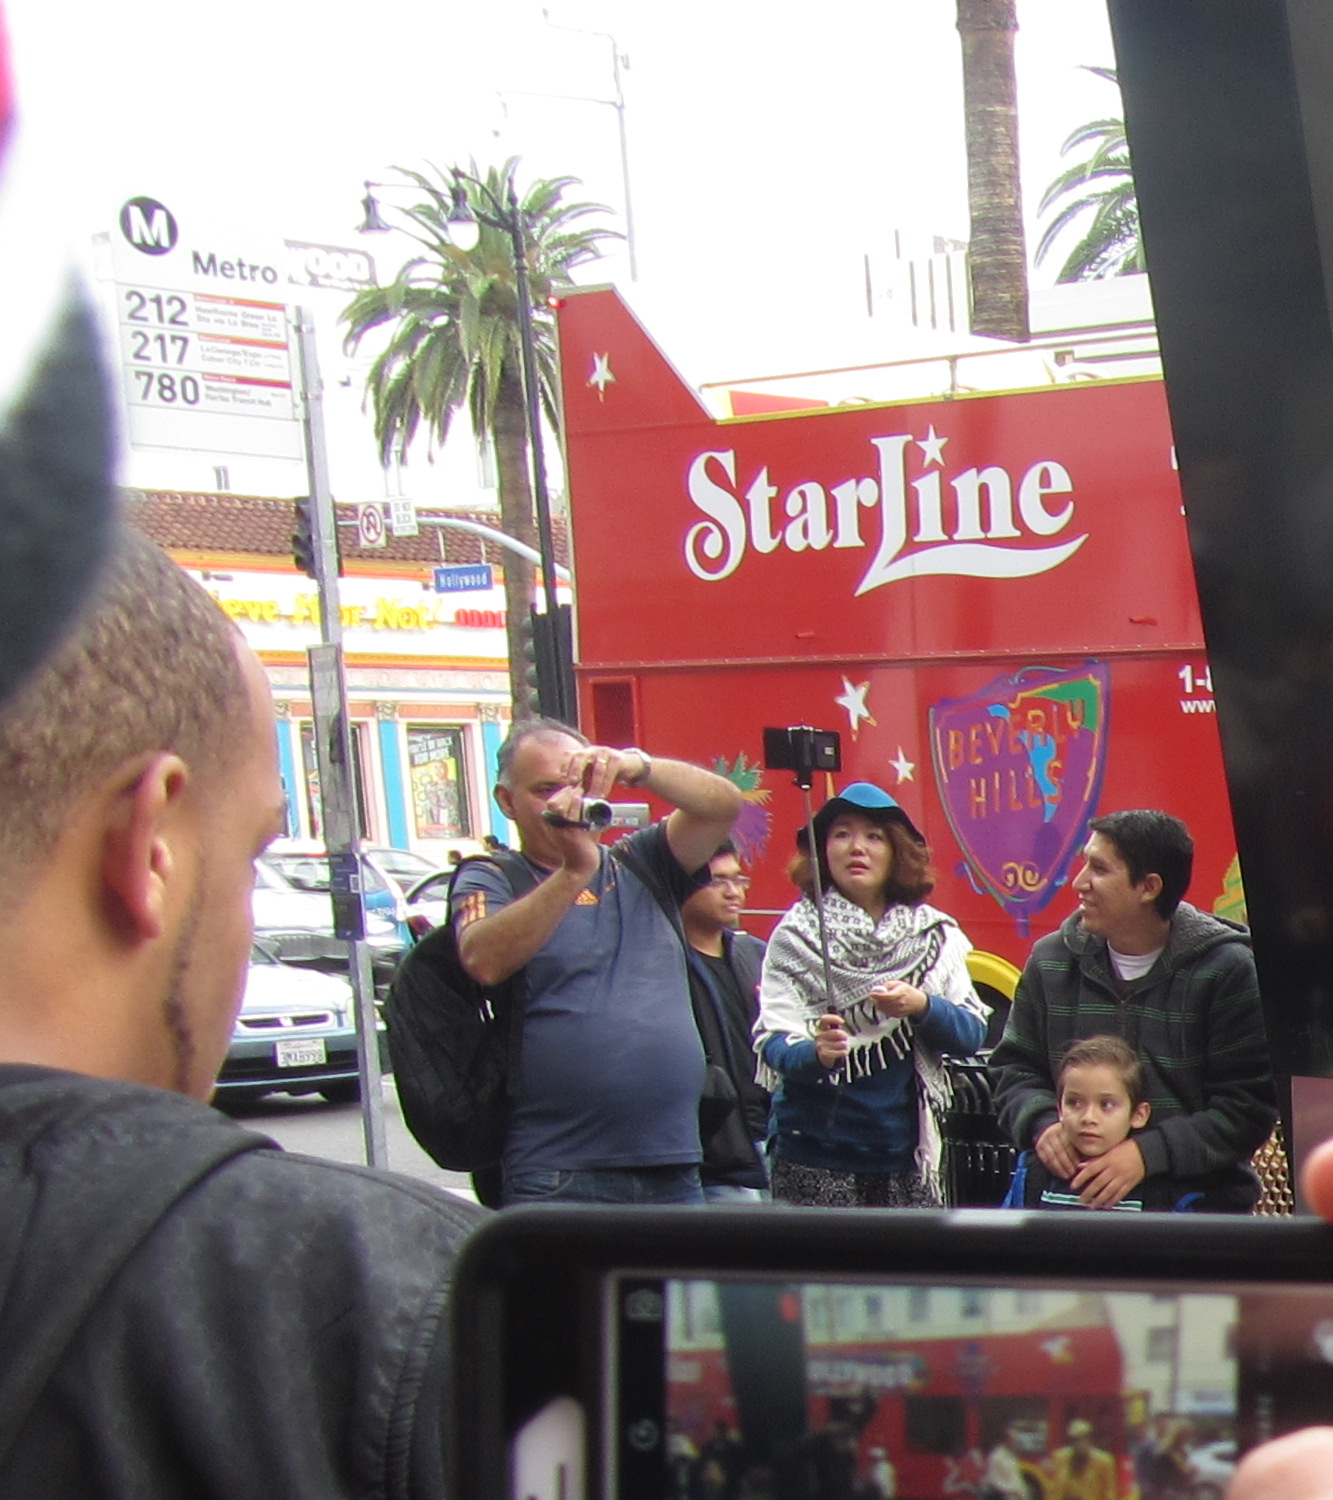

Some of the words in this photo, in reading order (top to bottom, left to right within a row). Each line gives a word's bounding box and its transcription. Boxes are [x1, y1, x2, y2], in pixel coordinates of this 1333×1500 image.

[127, 204, 171, 249] M
[192, 250, 278, 285] Metro
[125, 289, 189, 327] 212
[130, 330, 189, 366] 217
[134, 369, 200, 406] 780
[684, 425, 1089, 597] StarLine
[439, 571, 488, 589] Hollywood
[1180, 699, 1217, 714] ww
[947, 699, 1087, 769] BEVERLY
[970, 759, 1064, 820] HILLS
